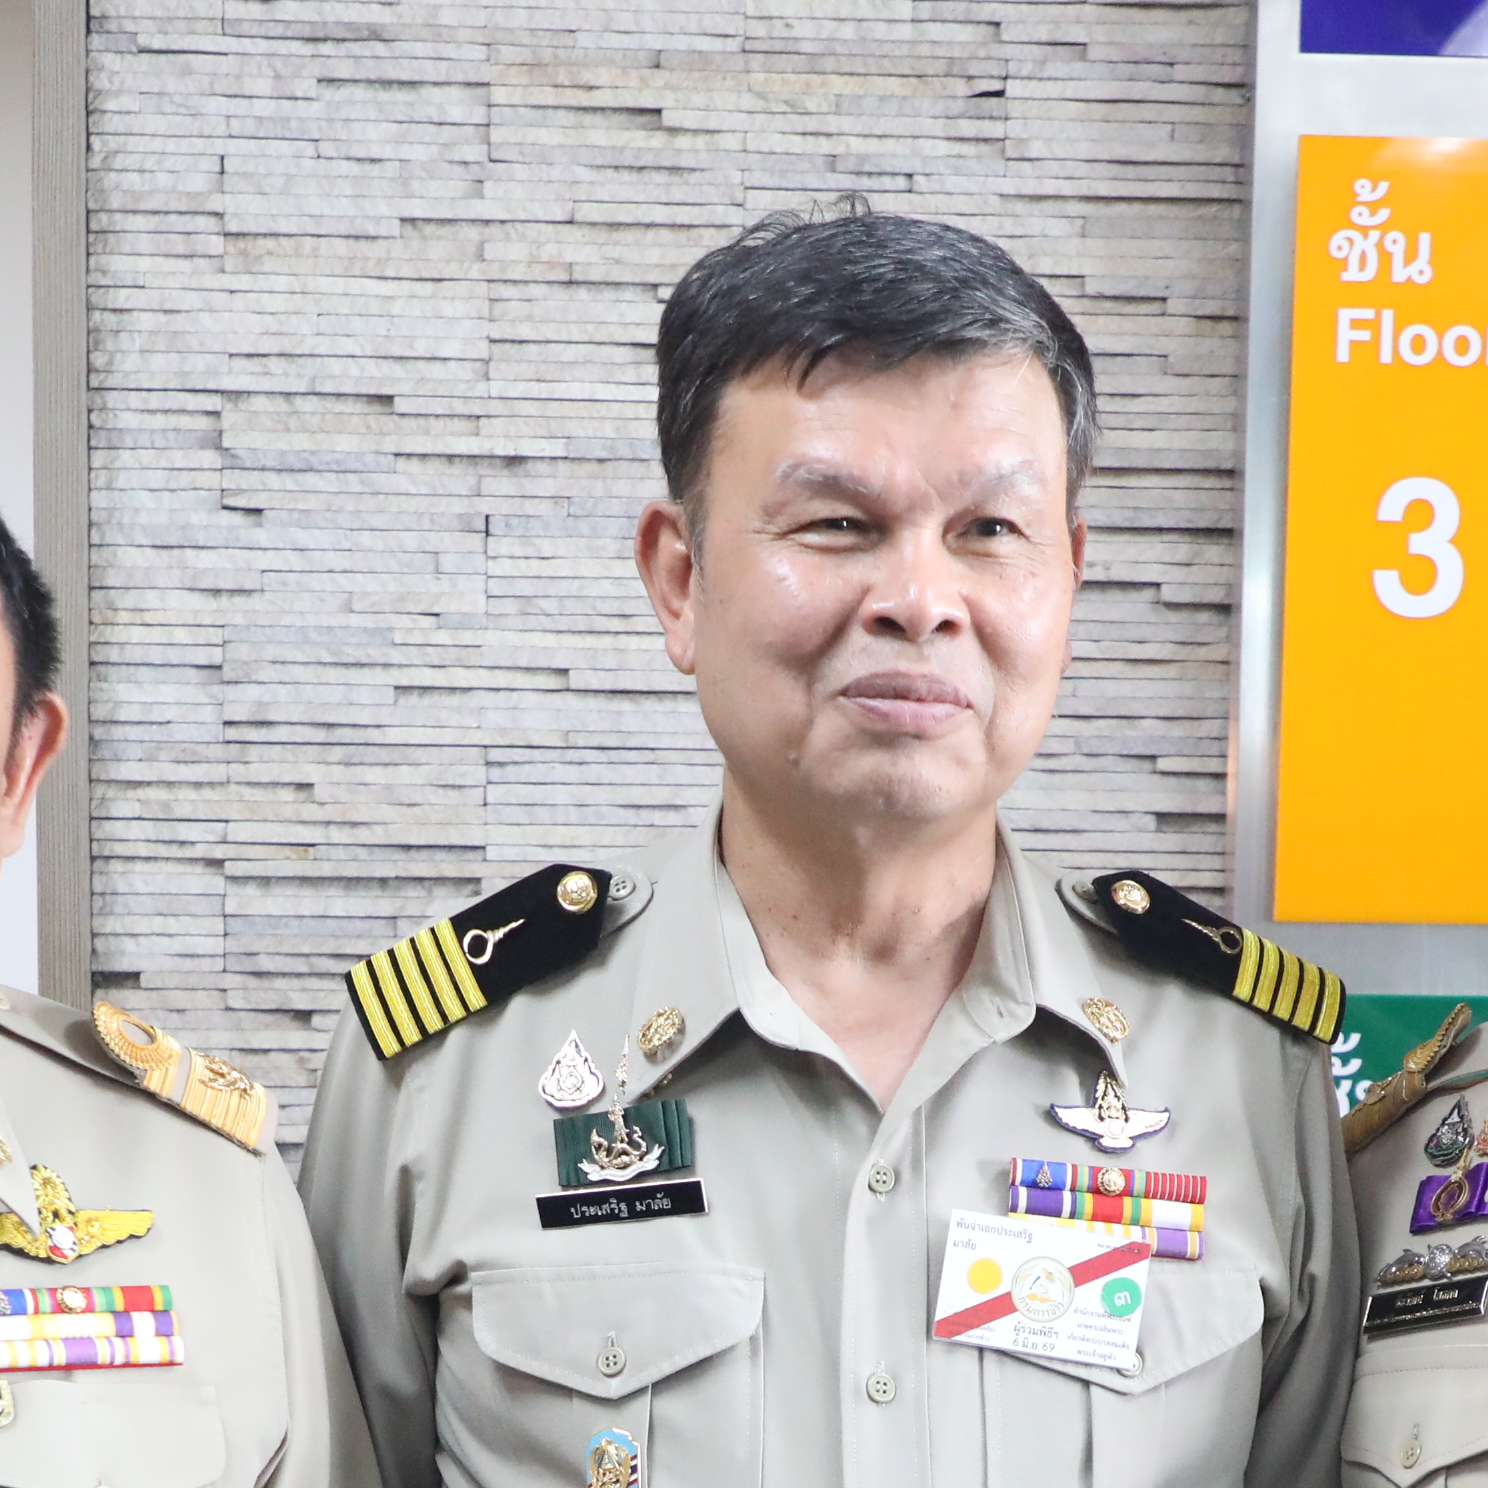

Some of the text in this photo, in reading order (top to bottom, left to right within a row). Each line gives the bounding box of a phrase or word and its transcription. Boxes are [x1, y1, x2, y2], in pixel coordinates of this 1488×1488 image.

[1328, 178, 1434, 285] ชั้น
[1372, 477, 1465, 619] 3
[570, 1192, 672, 1218] ประเสริฐ มาลัย
[952, 1238, 977, 1250] มาลัย
